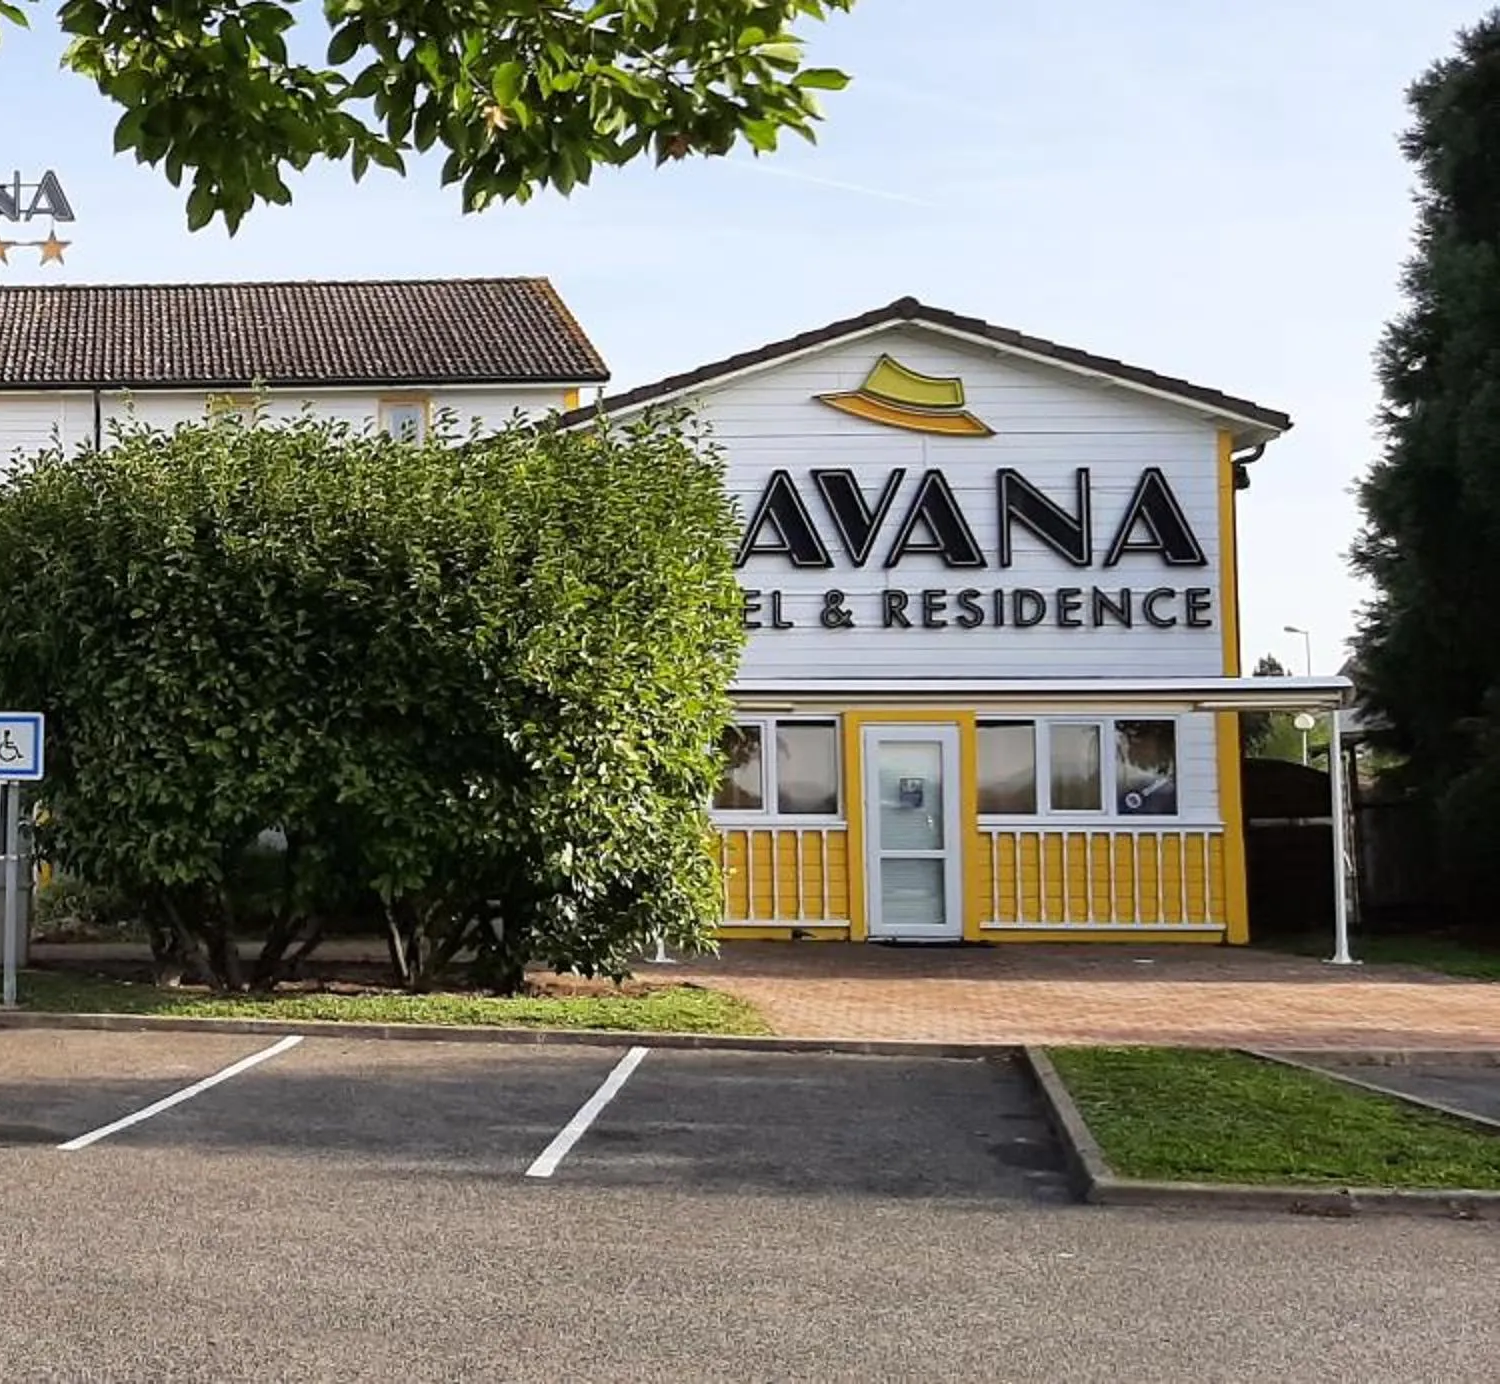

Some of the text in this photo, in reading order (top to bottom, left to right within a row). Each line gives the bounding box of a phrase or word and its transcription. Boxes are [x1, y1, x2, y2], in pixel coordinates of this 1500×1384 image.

[732, 467, 1209, 569] AVANA
[740, 586, 1213, 629] EL & RESIDENCE
